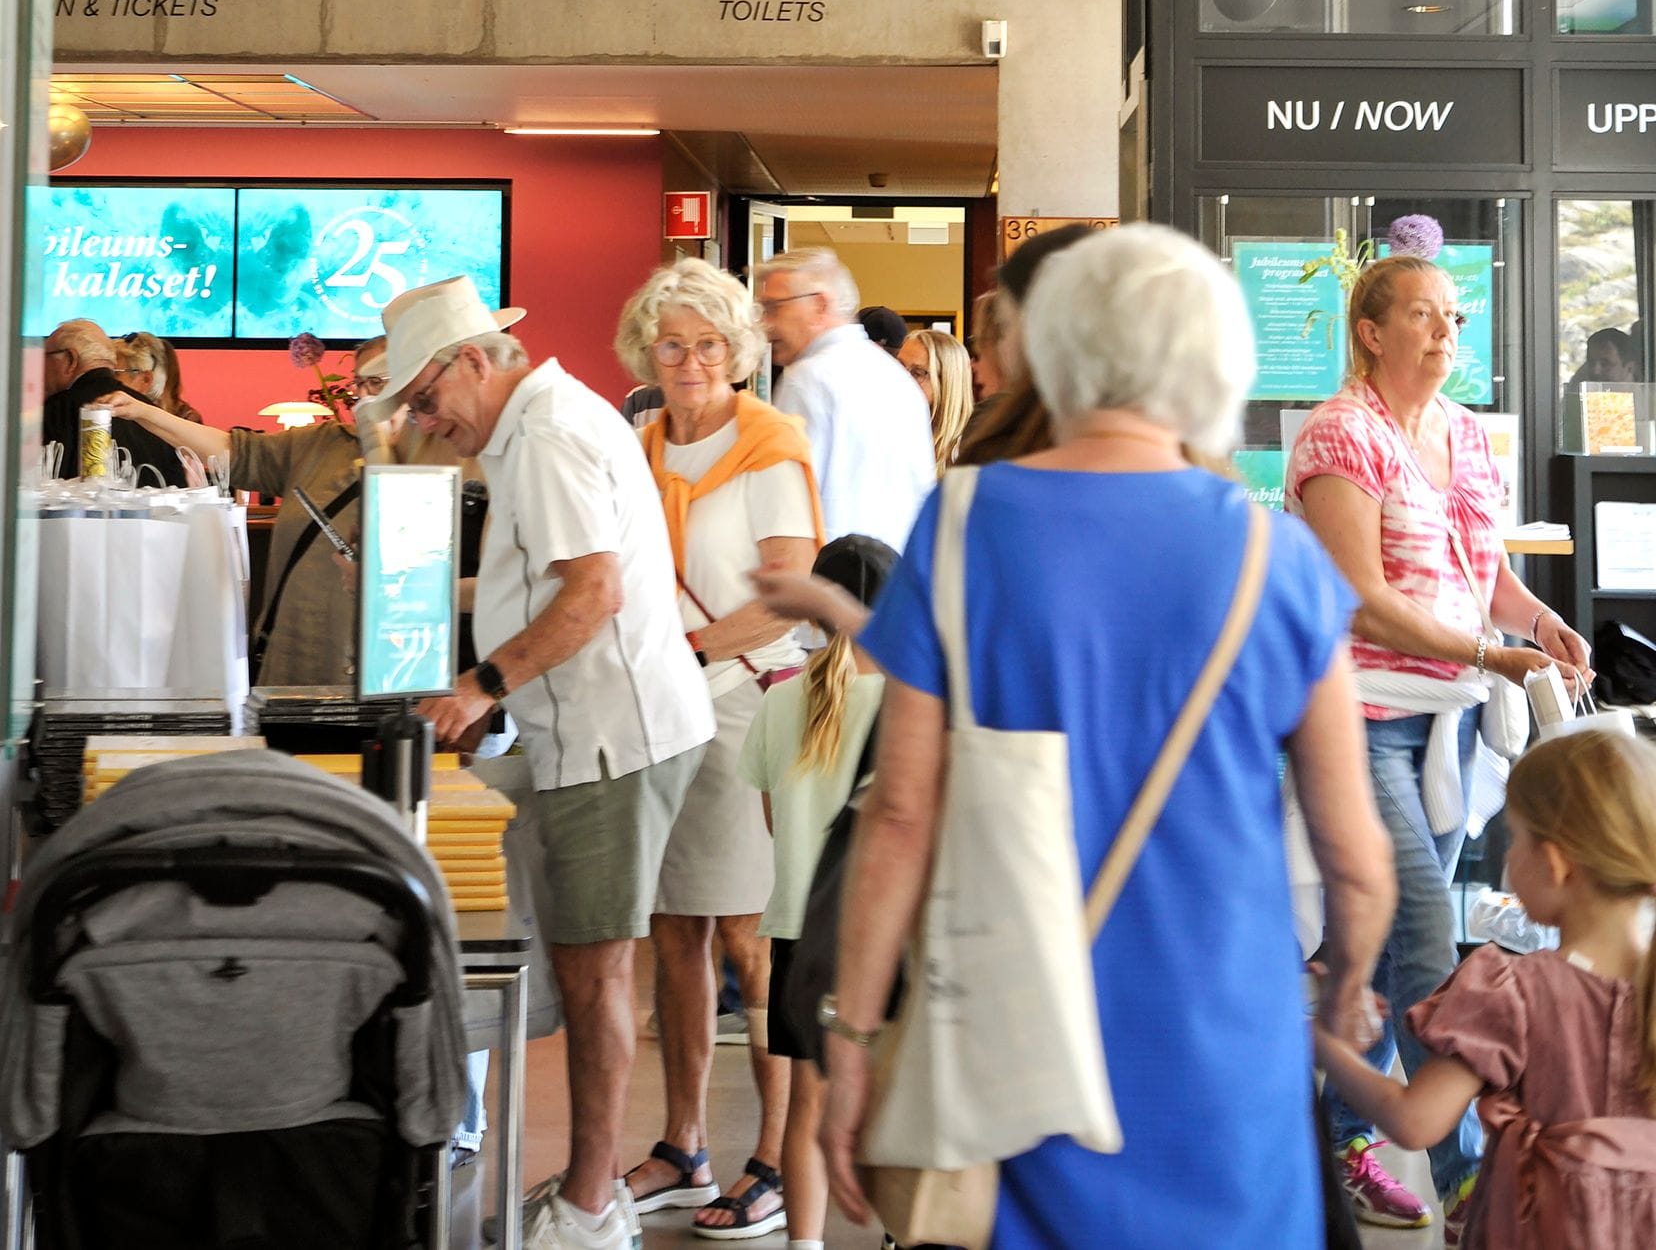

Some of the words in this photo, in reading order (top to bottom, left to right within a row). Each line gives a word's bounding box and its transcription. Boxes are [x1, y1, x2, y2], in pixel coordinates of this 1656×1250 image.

[719, 0, 826, 22] TOILETS
[1267, 100, 1320, 131] NU
[1330, 100, 1345, 130] /
[1354, 100, 1455, 131] NOW
[1587, 103, 1656, 133] UPP
[325, 219, 411, 309] 25
[53, 261, 217, 299] kalaset!
